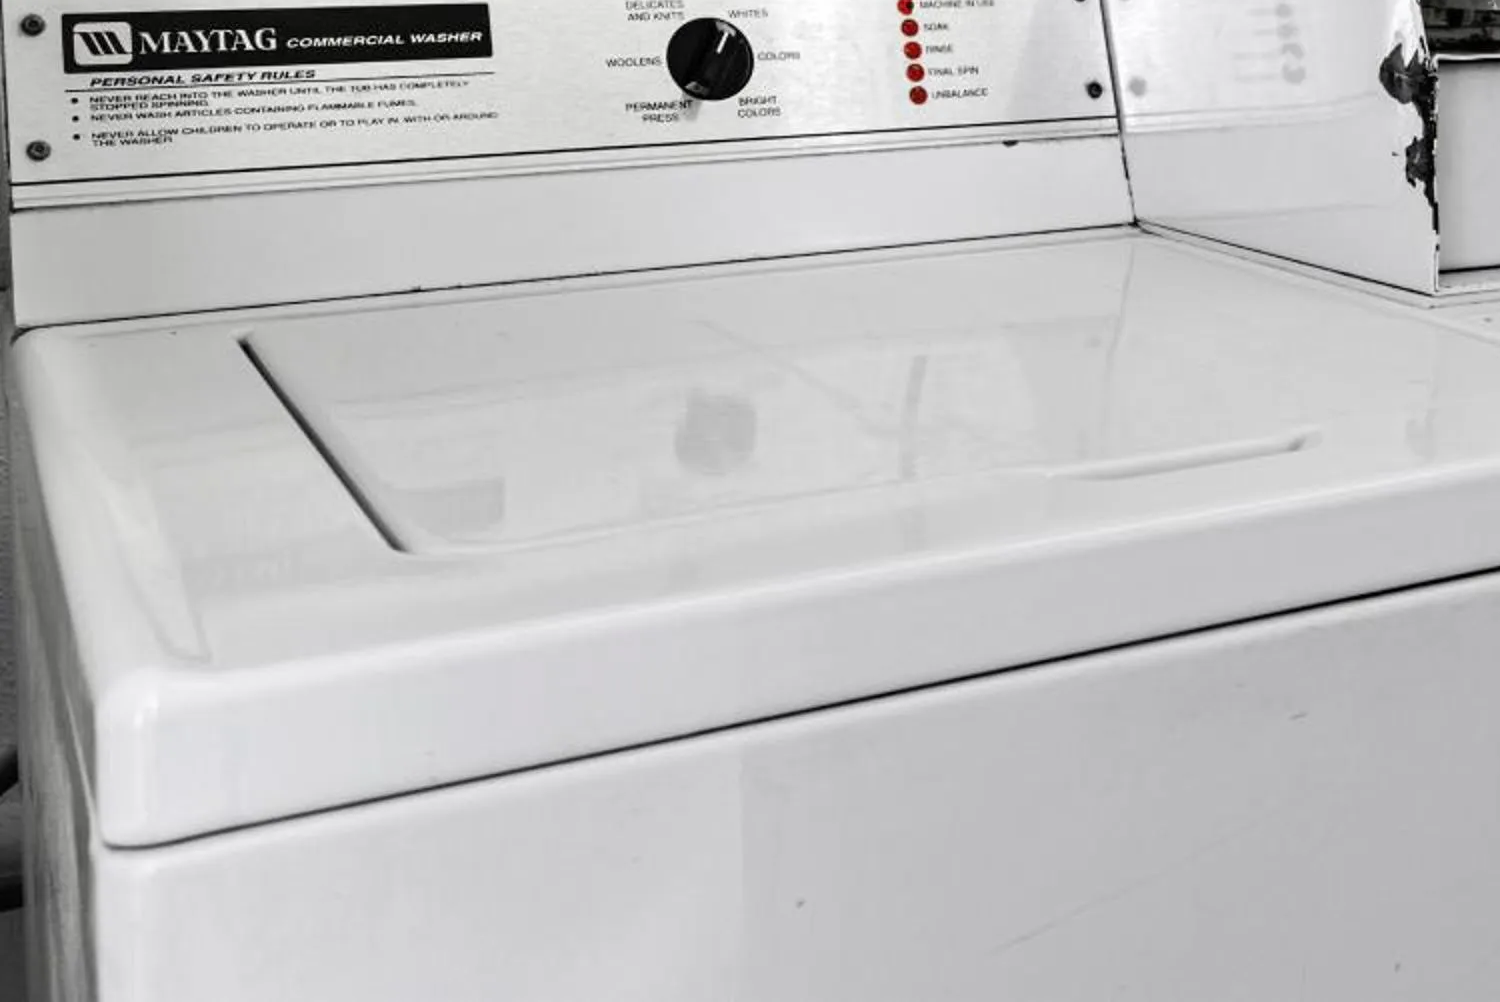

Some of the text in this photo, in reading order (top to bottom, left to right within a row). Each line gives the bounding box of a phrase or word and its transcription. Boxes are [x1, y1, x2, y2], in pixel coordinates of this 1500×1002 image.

[625, 0, 684, 10] DELICATES
[627, 11, 684, 22] AND KNITS
[728, 8, 768, 19] WHITES
[138, 27, 483, 55] MAYTAG COMMERCIAL WASHER
[606, 56, 662, 68] WOOLENS
[757, 51, 800, 61] COLORS
[90, 69, 316, 87] PERSONAL SAFETY RULES
[89, 95, 132, 103] NEVER
[135, 93, 177, 101] REACH
[210, 90, 232, 98] THE
[237, 88, 286, 97] WASHER
[738, 95, 777, 106] BRIGHT
[625, 99, 693, 112] PERMANENT
[91, 113, 133, 121] NEVER
[175, 108, 232, 117] ARTICLES
[642, 113, 680, 123] PRESS
[737, 107, 782, 119] COLORS
[91, 130, 134, 139] NEVER
[137, 128, 179, 137] ALLOW
[181, 125, 242, 135] CHILDREN
[246, 123, 261, 132] TO
[263, 121, 316, 131] OPERATE
[93, 139, 116, 147] THE
